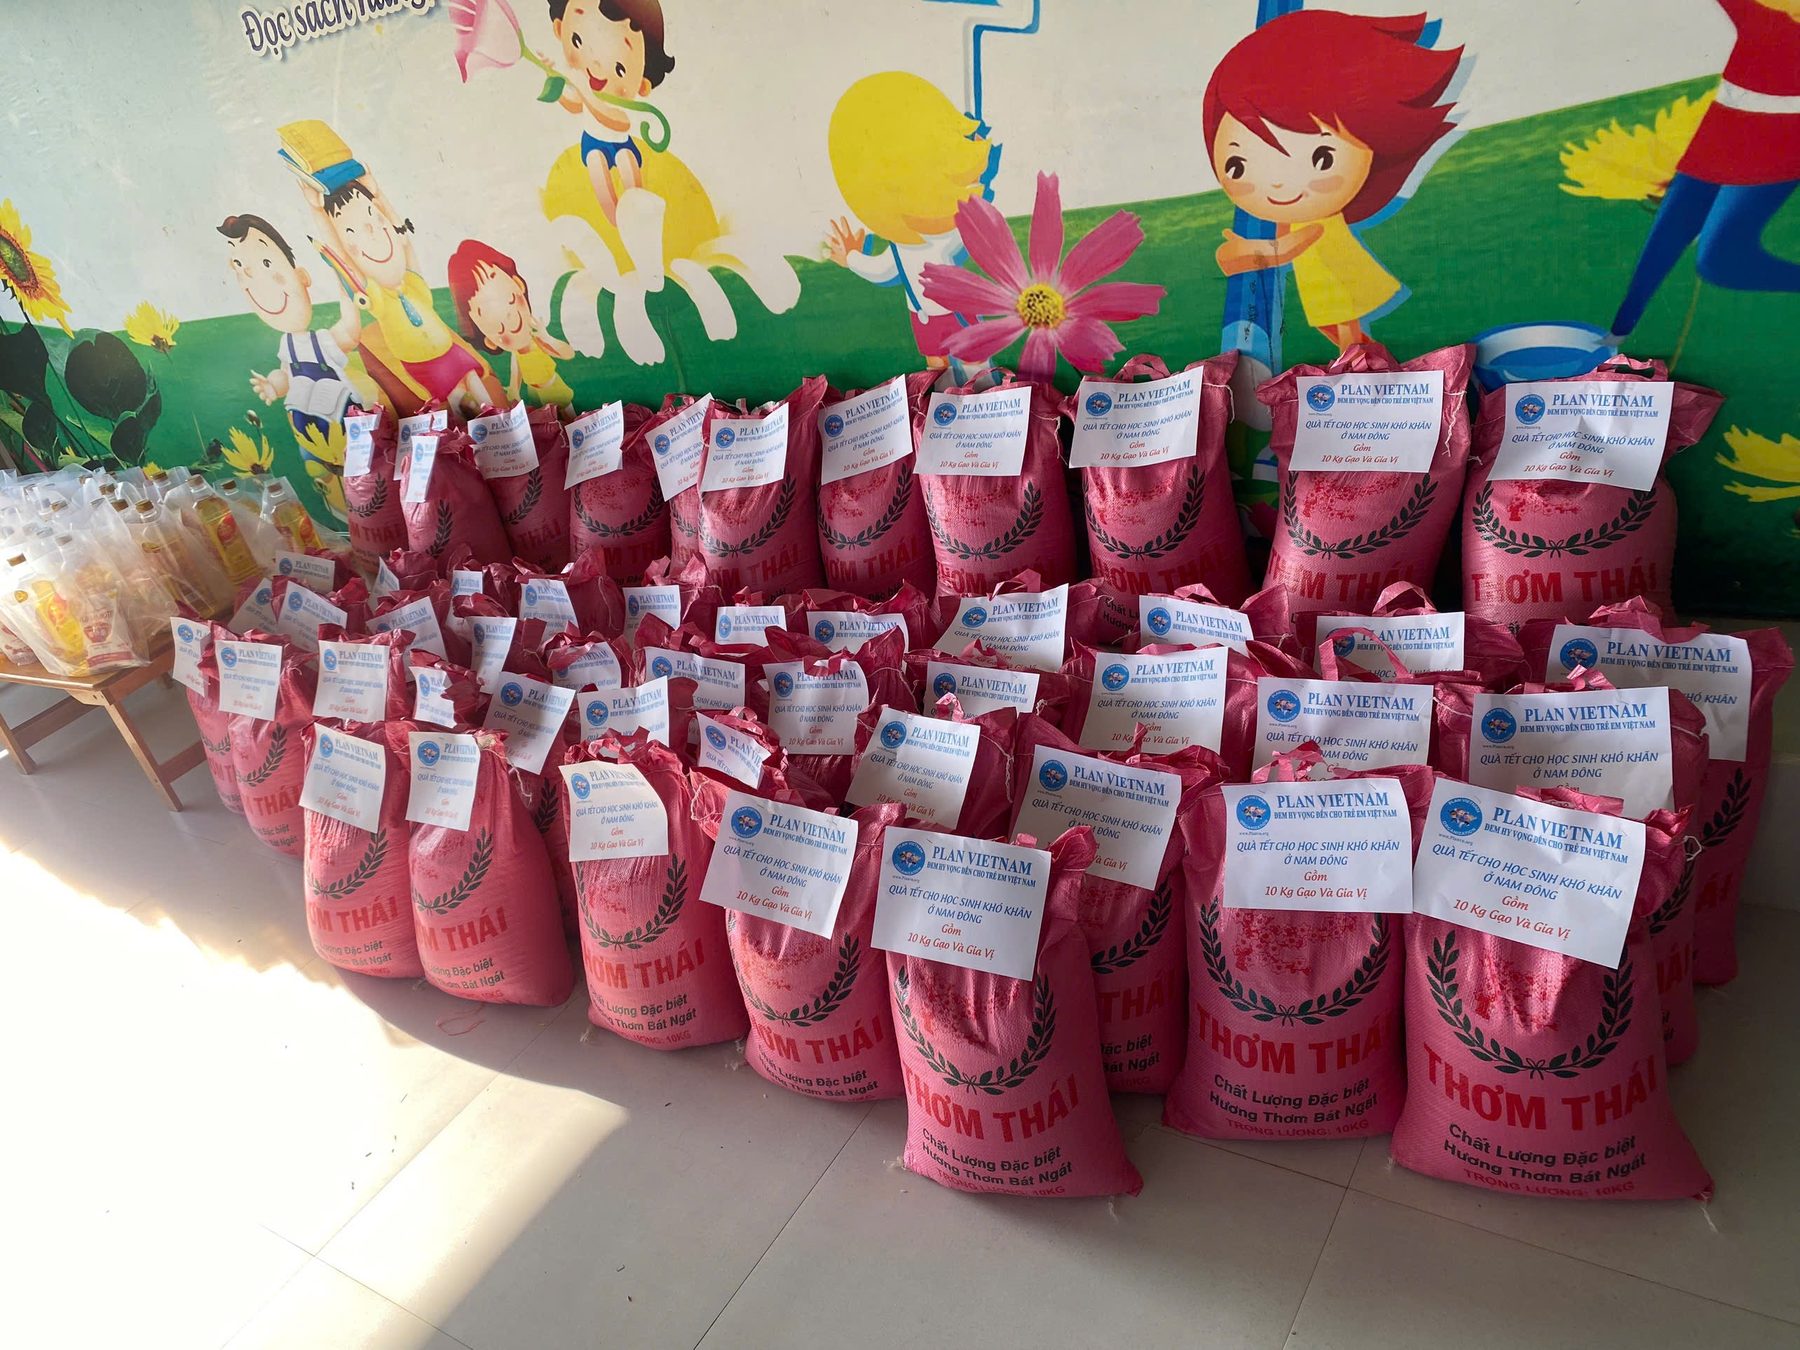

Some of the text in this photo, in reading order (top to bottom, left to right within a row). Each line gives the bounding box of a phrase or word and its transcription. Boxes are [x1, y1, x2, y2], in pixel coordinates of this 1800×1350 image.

[242, 11, 292, 54] Đọc
[1118, 381, 1191, 402] PLAN VIETNAM
[1341, 383, 1429, 395] PLAN VIETNAM
[846, 388, 900, 419] PLAN VIETNAM
[962, 399, 1021, 413] PLAN VIETNAM
[1552, 394, 1653, 407] PLAN VIETNAM
[992, 597, 1059, 616] PLAN VIETNAM
[734, 615, 779, 625] PLAN VIETNAM
[1175, 611, 1243, 633] PLAN VIETNAM
[1401, 626, 1450, 640] VIETNAM
[1607, 641, 1731, 662] PLAN VIETNAM
[1136, 659, 1214, 675] PLAN VIETNAM
[961, 676, 1027, 695] PLAN VIETNAM
[1308, 692, 1414, 711] PLAN VIETNAM
[1525, 704, 1647, 722] PLAN VIETNAM
[1640, 721, 1656, 729] NAM
[912, 726, 970, 748] PLAN VIETNAM
[1074, 766, 1165, 796] PLAN VIETNAM
[1277, 792, 1389, 809] PLAN VIETNAM
[770, 814, 846, 844] PLAN VIETNAM
[1492, 807, 1623, 849] PLAN VIETNAM
[1237, 840, 1256, 852] QUÀ
[1260, 839, 1275, 850] TẾT
[1275, 842, 1295, 851] CHO
[1298, 842, 1318, 853] HỌC
[1321, 841, 1344, 851] SINH
[1345, 839, 1368, 851] KHÓ
[932, 846, 1032, 876] PLAN VIETNAM
[1294, 857, 1317, 865] NAM
[1432, 843, 1455, 857] QUÀ
[1458, 849, 1478, 862] TẾT
[1478, 856, 1501, 869] CHO
[1502, 862, 1528, 876] HỌC
[1528, 869, 1559, 884] SINH
[1560, 877, 1585, 891] KHÓ
[1304, 870, 1328, 881] Gồm
[1494, 876, 1523, 891] NAM
[889, 884, 907, 896] QUÀ
[923, 890, 939, 902] CHO
[940, 894, 959, 906] HỌC
[959, 897, 982, 910] SINH
[983, 902, 1002, 913] KHÓ
[1265, 887, 1368, 900] 10 Kg Gạo Và Gia Vị
[1502, 895, 1529, 911] Gồm
[336, 895, 400, 934] THÁI
[935, 907, 955, 918] NAM
[1454, 899, 1571, 941] 10 Kg Gạo Và Gia Vị
[441, 906, 508, 951] THÁI
[908, 933, 995, 960] 10 Kg Gạo Và Gia Vị
[634, 941, 705, 988] THÁI
[666, 994, 687, 1010] biệt
[805, 1017, 884, 1064] THÁI
[1197, 1004, 1396, 1075] THƠM THÁI
[1214, 1074, 1247, 1100] Chất
[1253, 1091, 1302, 1109] Lượng
[1343, 1078, 1370, 1099] biệt
[1423, 1041, 1658, 1131] THƠM THÁI
[903, 1059, 1080, 1143] THƠM THÁI
[1210, 1090, 1378, 1123] Hương Thơm Bát Ngát
[1336, 1119, 1370, 1133] 10KG
[923, 1128, 949, 1155] Chất
[952, 1148, 996, 1172] Lượng
[1034, 1145, 1061, 1167] biệt
[1449, 1124, 1490, 1154] Chất
[1496, 1146, 1556, 1167] Lượng
[1604, 1135, 1636, 1159] biệt
[922, 1142, 1073, 1186] Hương Thơm Bát Ngát
[1444, 1139, 1647, 1184] Hương Thơm Bát Ngát
